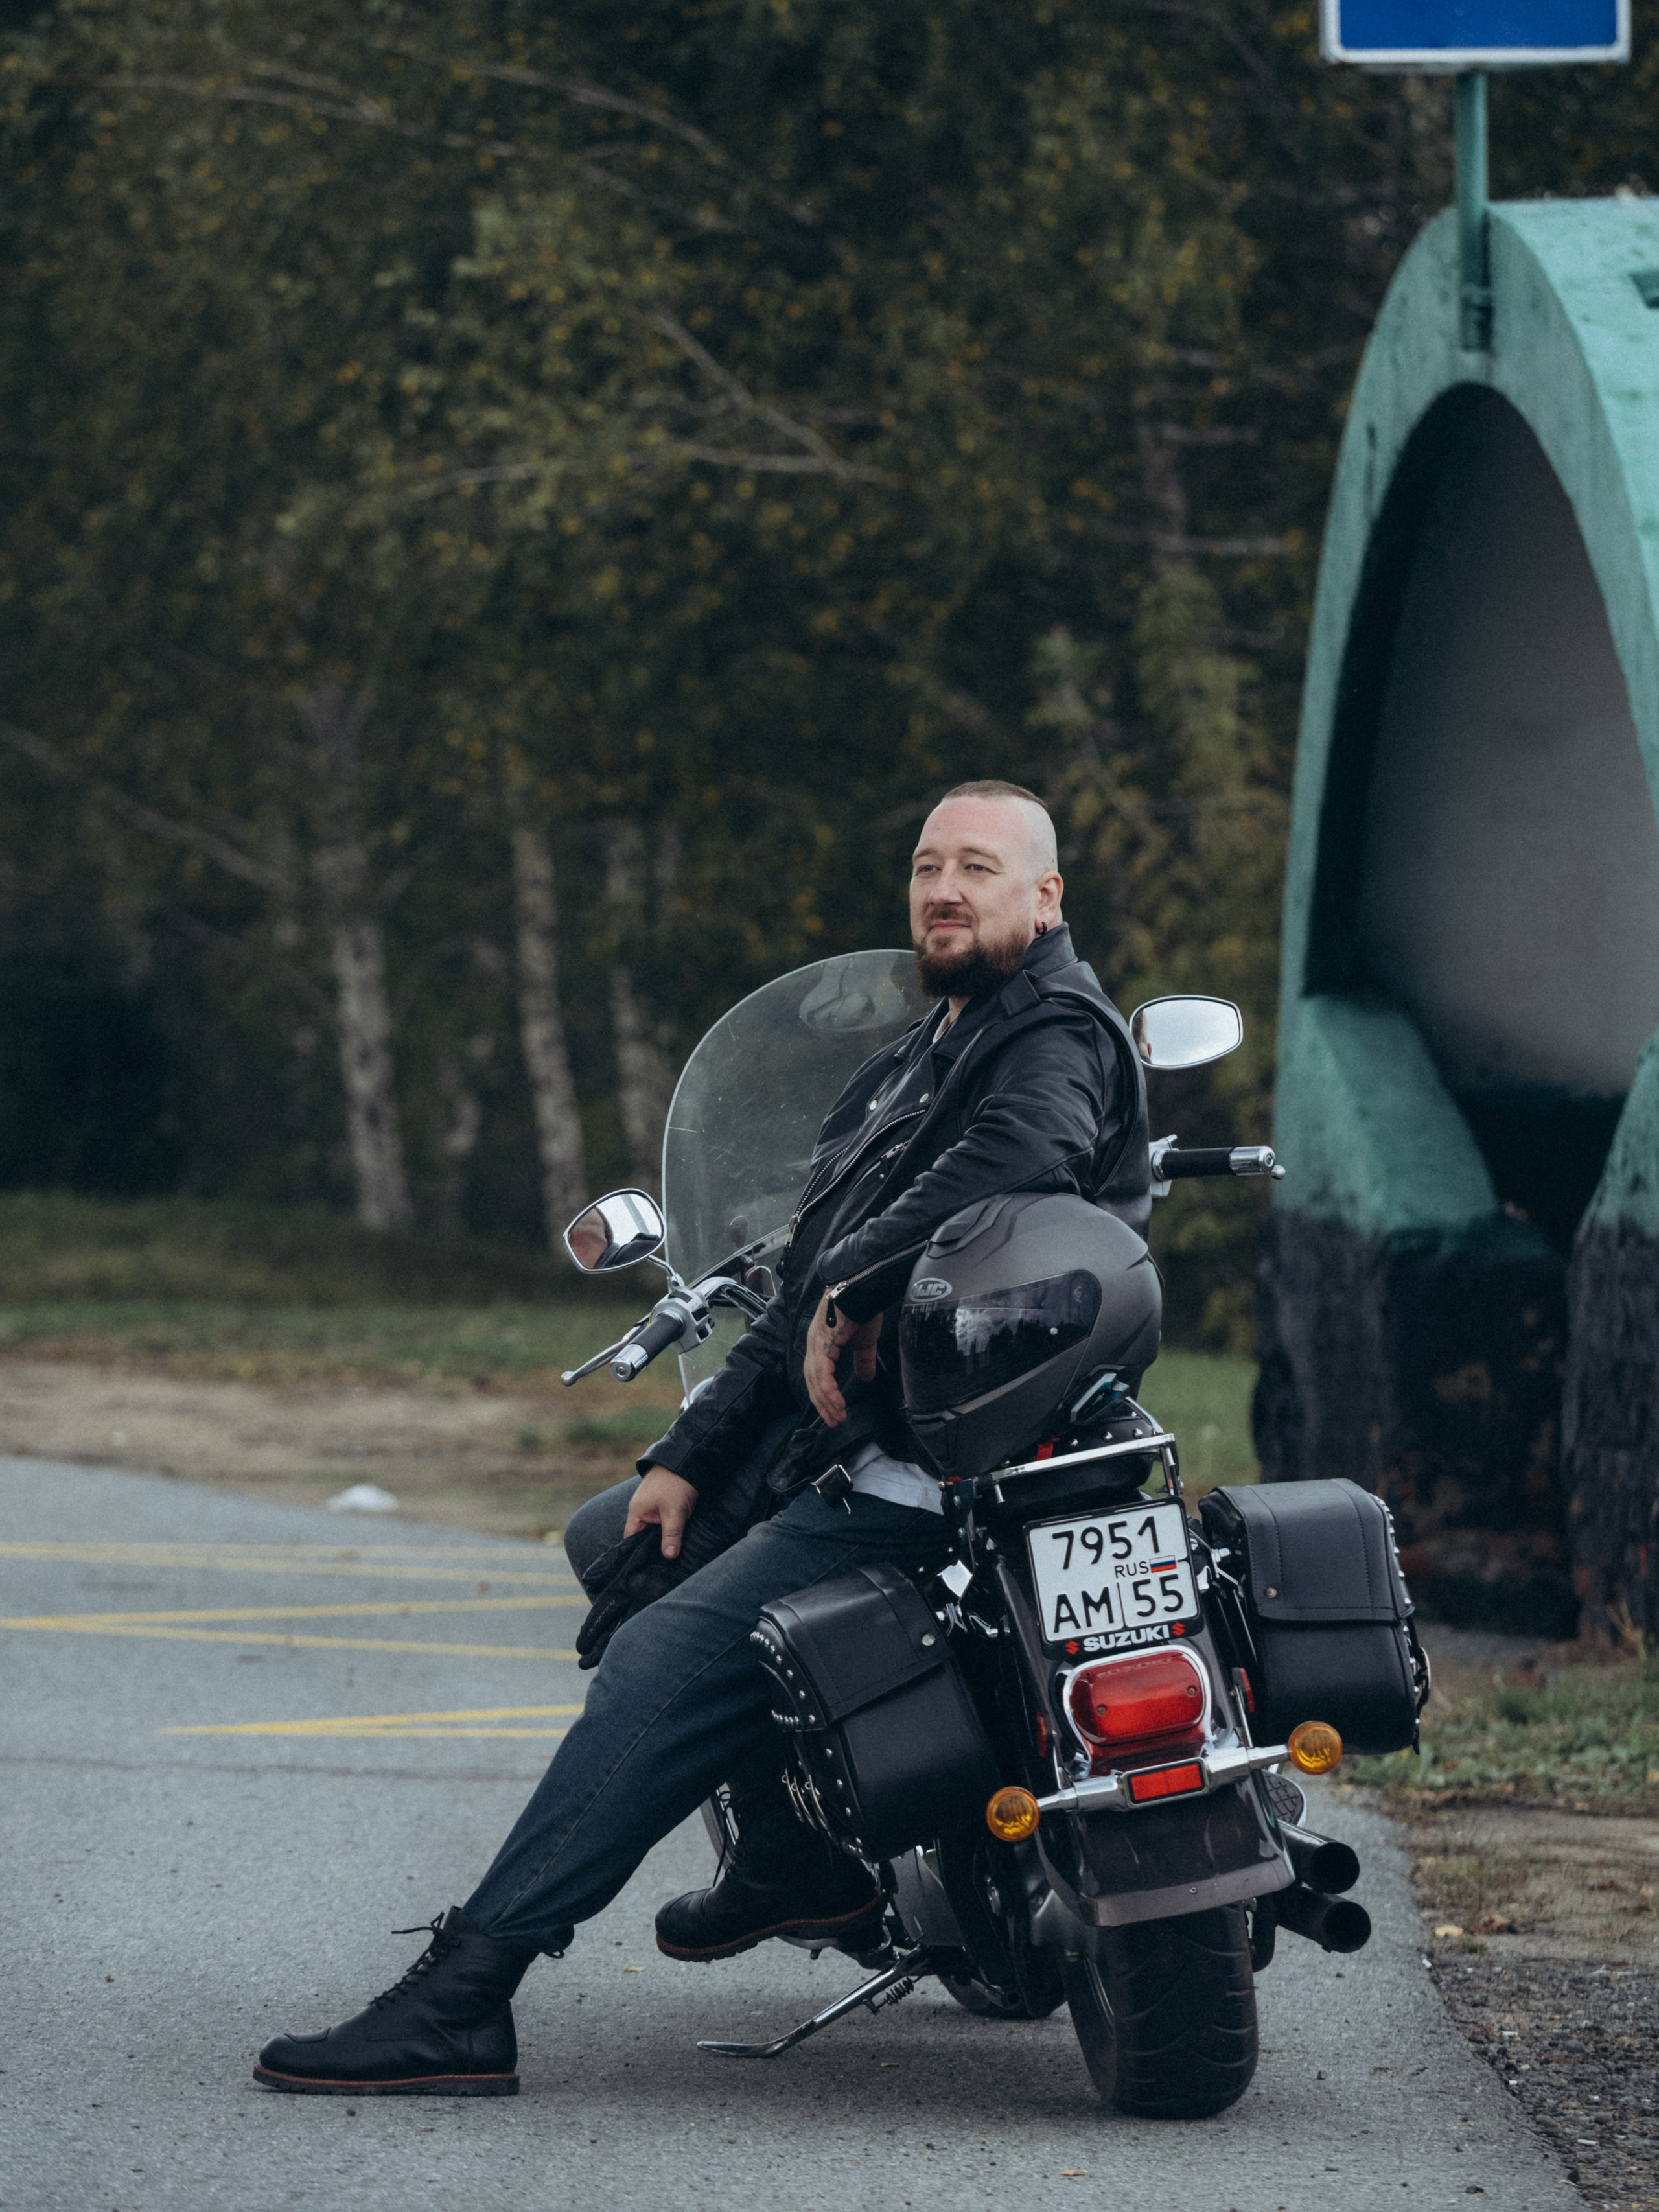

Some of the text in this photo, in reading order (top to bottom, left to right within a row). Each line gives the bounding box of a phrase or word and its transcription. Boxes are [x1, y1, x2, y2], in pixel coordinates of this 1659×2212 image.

[912, 1283, 946, 1296] HJC
[1052, 1515, 1160, 1570] 7951
[1114, 1561, 1149, 1578] RUS
[1054, 1574, 1184, 1633] AM 55
[1083, 1624, 1170, 1651] SUZUKI
